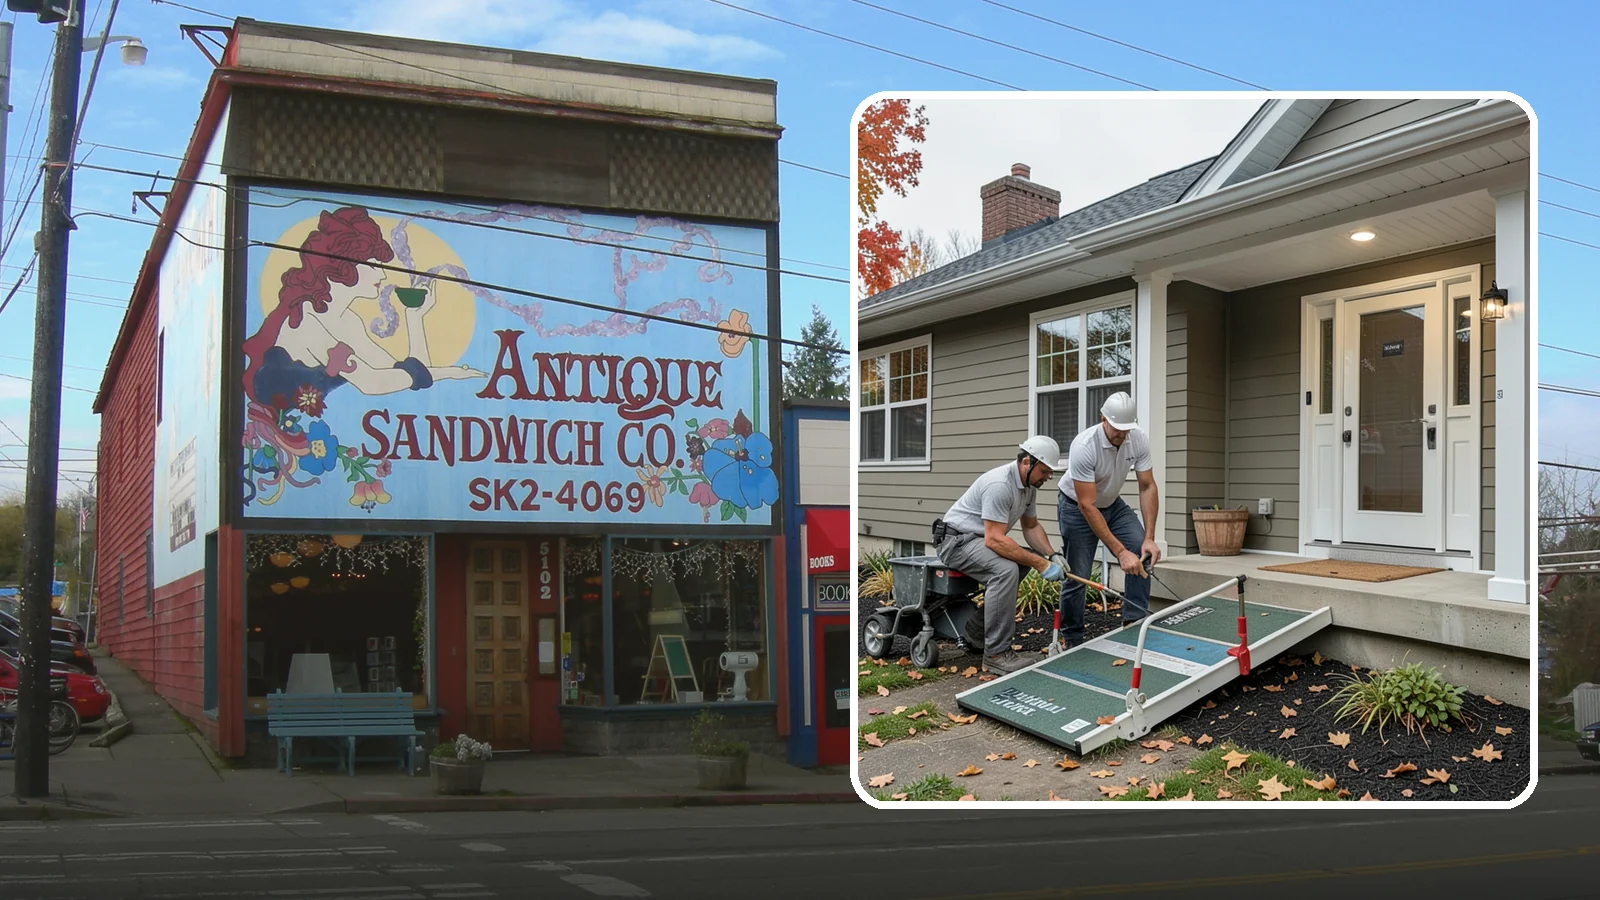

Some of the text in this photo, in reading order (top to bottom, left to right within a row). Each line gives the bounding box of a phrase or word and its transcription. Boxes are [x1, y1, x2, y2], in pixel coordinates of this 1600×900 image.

[475, 329, 723, 420] ANTIQUE
[361, 408, 685, 469] SANDWICH CO.
[468, 476, 646, 513] SK2-4069
[539, 541, 551, 600] 5102
[809, 555, 834, 568] BOOKS
